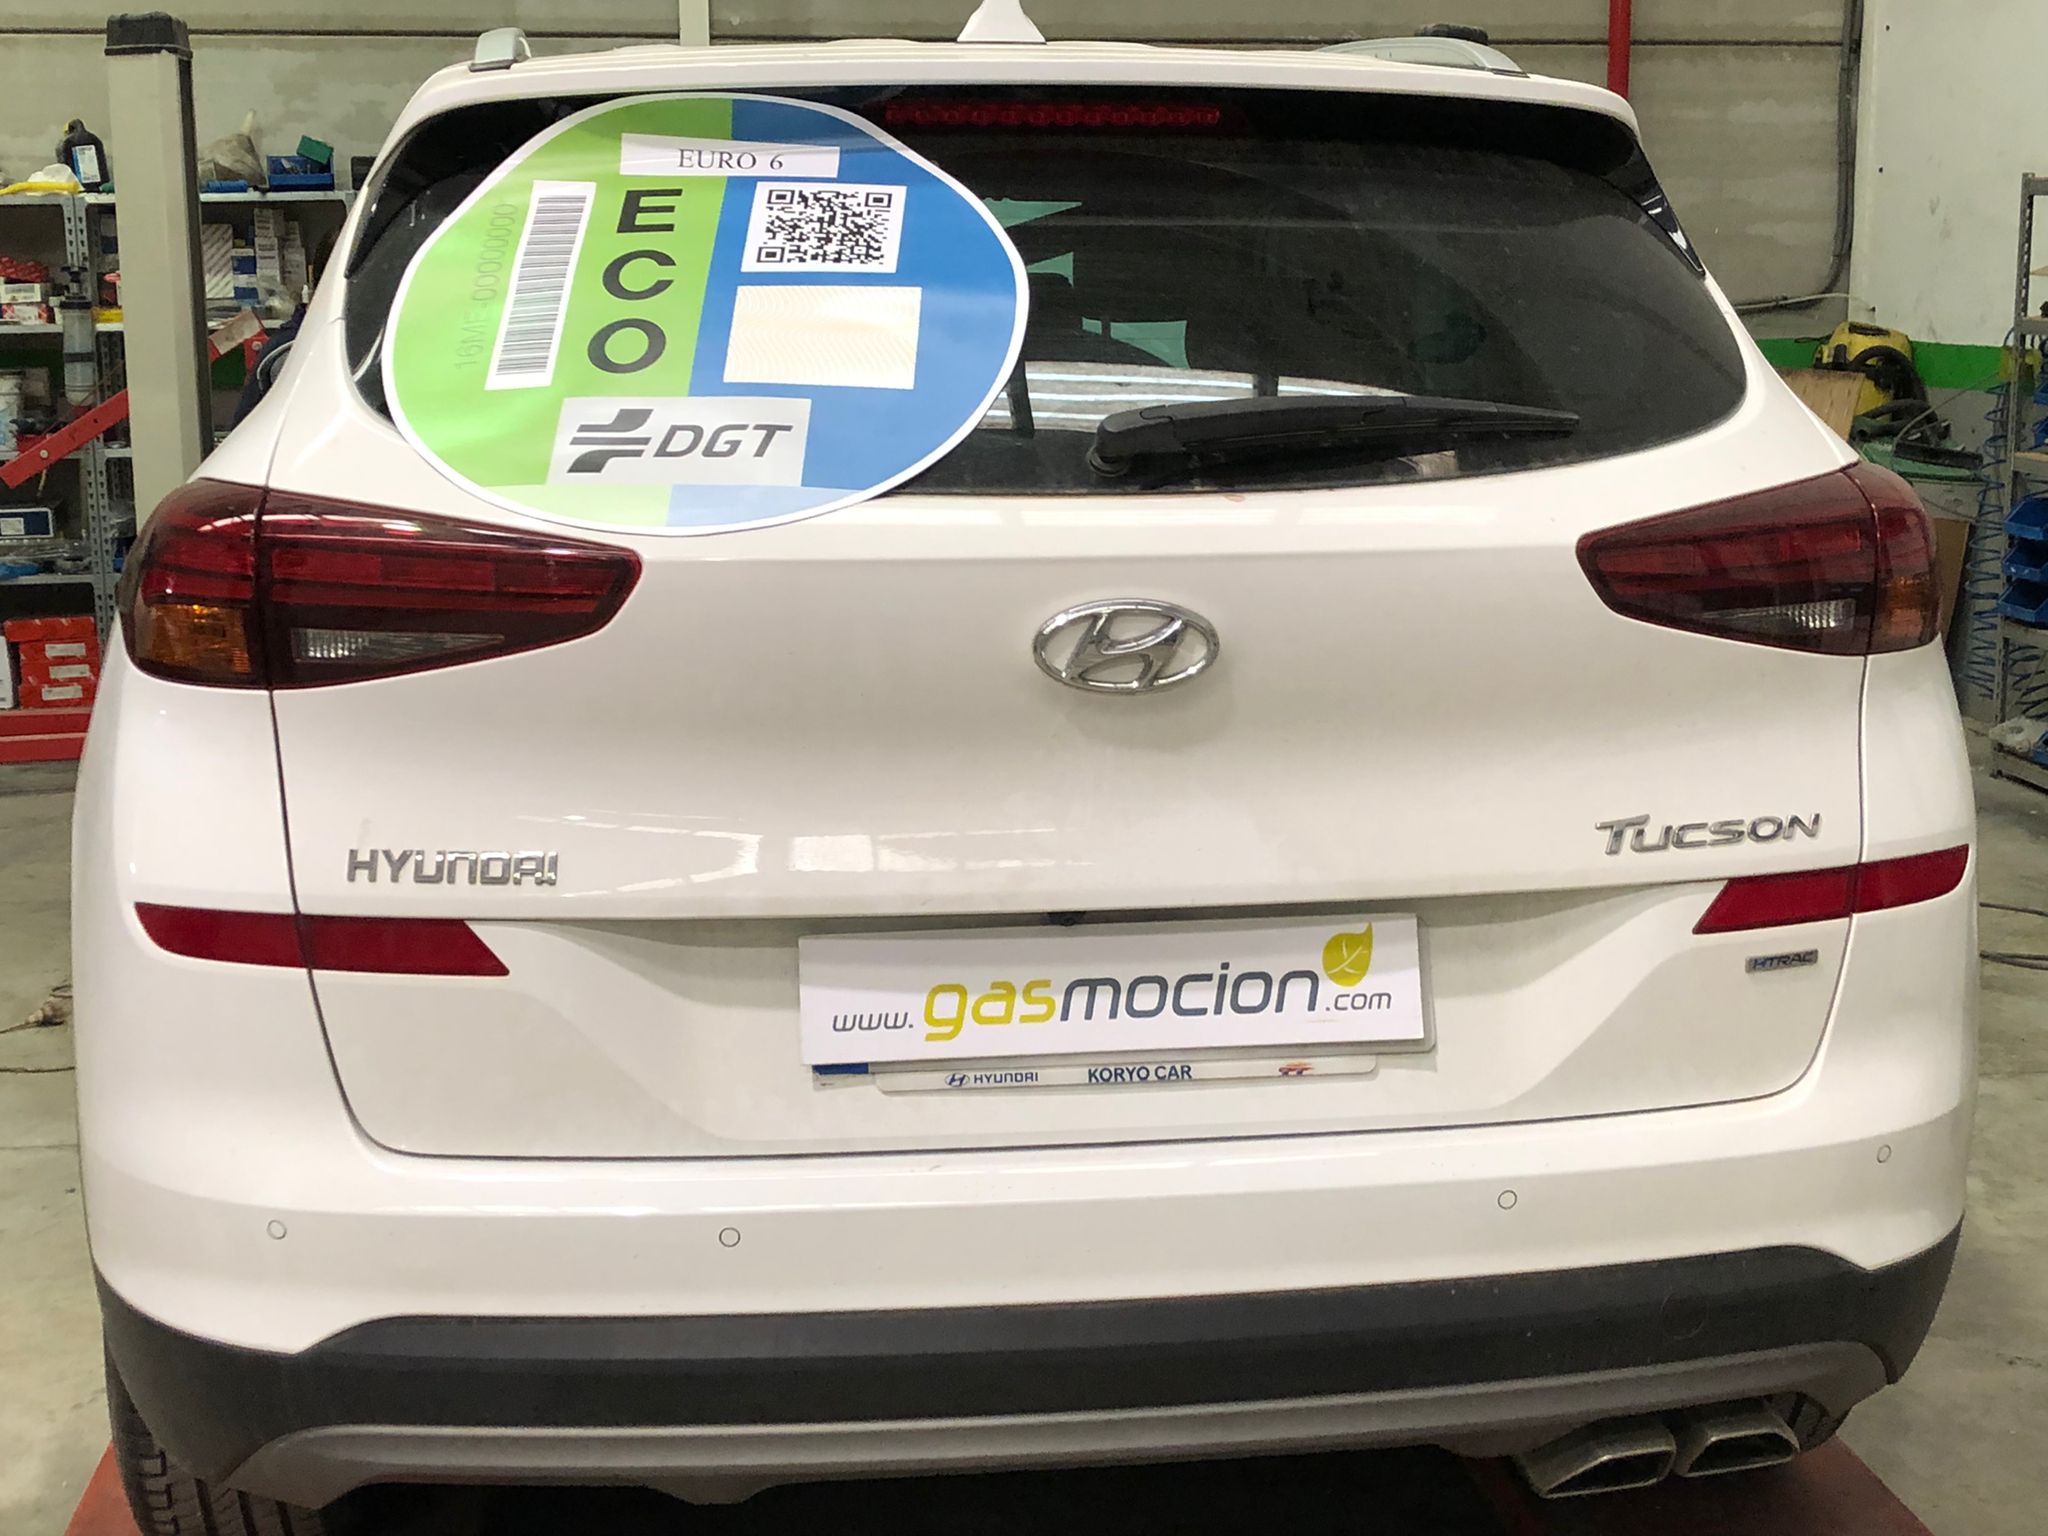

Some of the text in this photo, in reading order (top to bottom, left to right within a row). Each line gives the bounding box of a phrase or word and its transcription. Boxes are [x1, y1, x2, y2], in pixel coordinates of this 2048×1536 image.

[679, 148, 784, 170] EURO 6
[587, 188, 683, 374] ECO
[653, 424, 793, 458] DGT
[1595, 812, 1821, 856] TUCSON
[347, 848, 559, 885] HYUNDAI
[1751, 950, 1814, 971] HTRAC
[973, 1071, 1039, 1085] HYUNDAI
[1088, 1064, 1193, 1083] KORYO CAR
